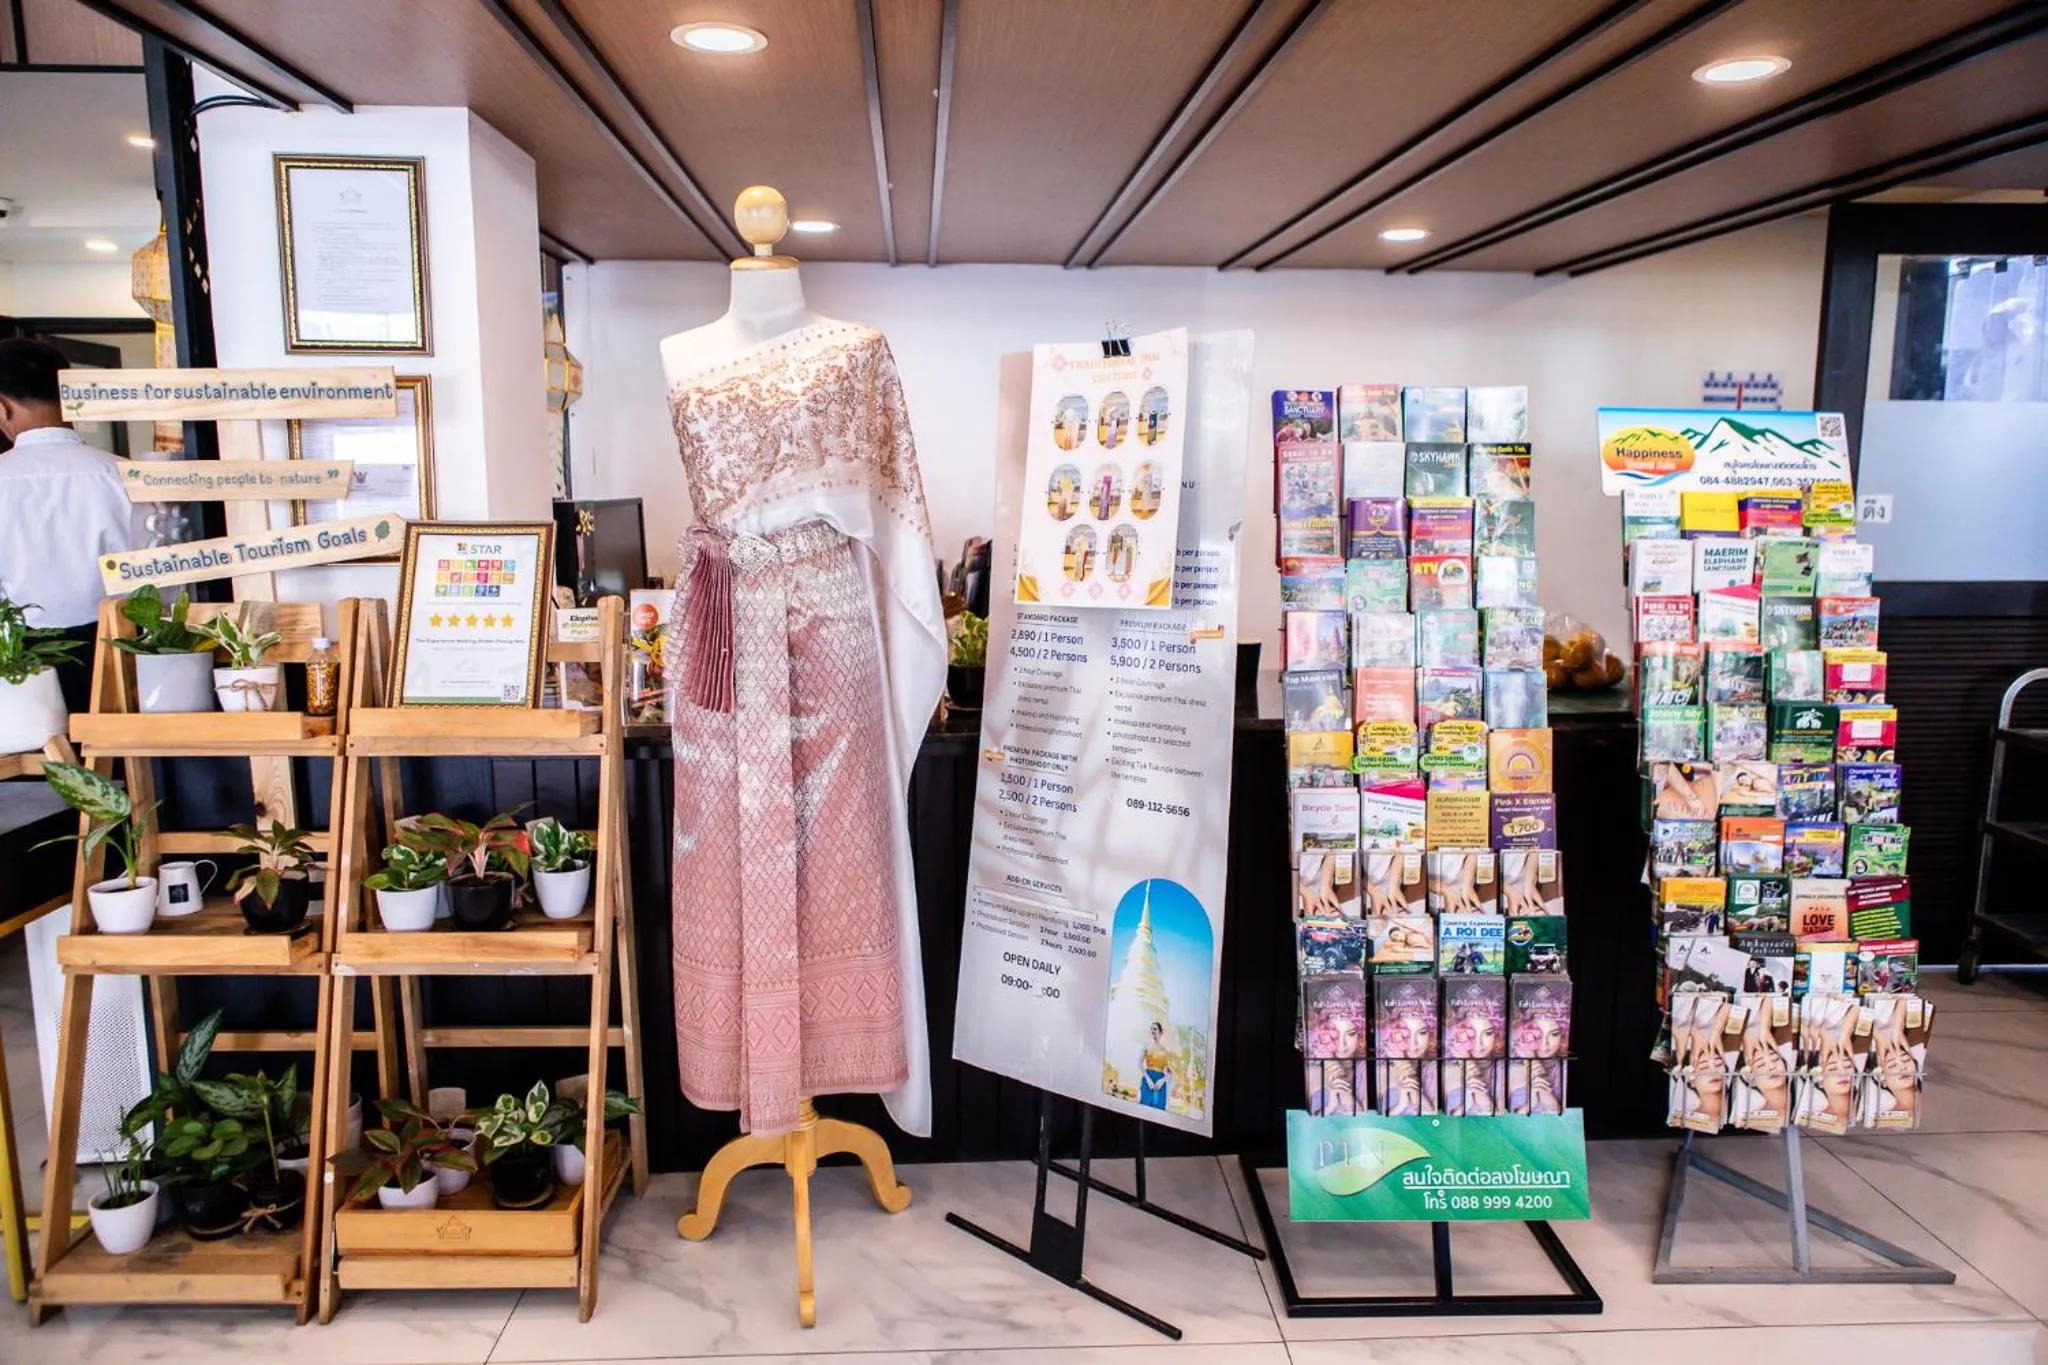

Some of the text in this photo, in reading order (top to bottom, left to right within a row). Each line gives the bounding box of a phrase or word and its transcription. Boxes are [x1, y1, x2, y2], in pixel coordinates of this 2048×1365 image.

[60, 381, 393, 400] Business for sustainable environment
[1616, 447, 1682, 459] Happiness
[216, 473, 258, 489] people
[259, 473, 273, 485] to
[120, 527, 367, 580] Sustainable Tourism Goals
[470, 543, 502, 554] STAR
[1704, 547, 1749, 557] MAERIM
[1414, 561, 1438, 576] ATV
[1180, 582, 1191, 590] per
[1050, 614, 1079, 623] PACKAGE
[1051, 632, 1084, 645] Person
[1111, 636, 1141, 650] 3,500
[1159, 641, 1196, 654] Person
[1010, 646, 1036, 659] 4,500
[1042, 649, 1049, 660] 2
[1051, 650, 1087, 663] Persons
[1110, 655, 1140, 669] 5,900
[1149, 658, 1156, 670] 2
[1159, 659, 1202, 674] Persons
[1037, 668, 1062, 679] Coverage
[1144, 693, 1172, 703] premium
[1031, 748, 1060, 759] PACKAGE
[1000, 772, 1026, 786] 1,500
[1040, 779, 1074, 794] Person
[998, 788, 1024, 803] 2,500
[1031, 795, 1038, 806] 2
[1040, 796, 1078, 813] Persons
[1126, 798, 1190, 817] 089-112-5656
[1301, 804, 1332, 813] Bicycle
[1509, 822, 1539, 834] 1,700
[1802, 913, 1836, 926] LOVE
[1044, 926, 1059, 937] hour
[1443, 927, 1504, 937] A ROI DEE
[1045, 939, 1063, 951] hours
[1002, 951, 1061, 976] OPEN DAILY
[1451, 1196, 1482, 1209] 088
[1483, 1196, 1511, 1209] 999
[1515, 1196, 1552, 1209] 4200
